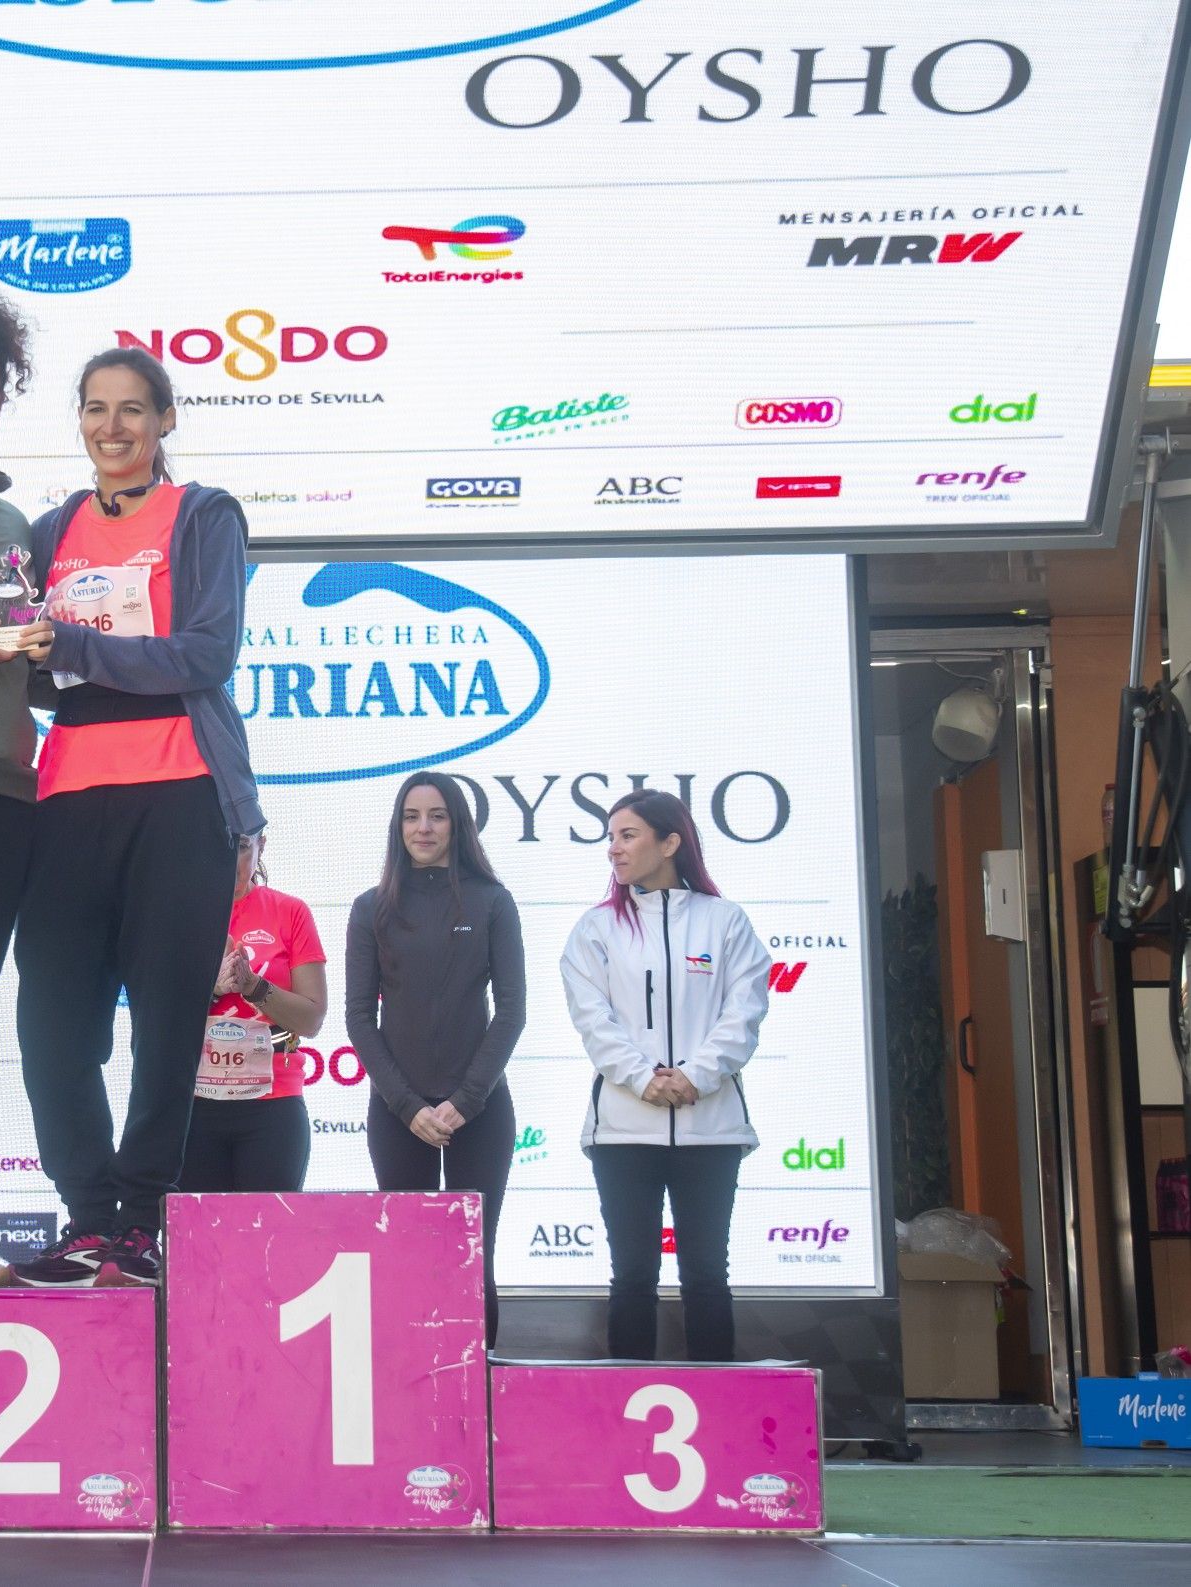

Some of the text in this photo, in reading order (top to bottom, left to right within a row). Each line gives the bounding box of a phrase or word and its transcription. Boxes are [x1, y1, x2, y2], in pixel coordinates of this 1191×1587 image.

[464, 38, 1033, 130] OYSHO
[778, 204, 1085, 225] MENSAJERÍA OFICIAL
[806, 230, 1024, 268] MRW
[381, 269, 524, 284] TotalEnergies
[176, 394, 272, 406] TAMIENTO
[278, 393, 303, 405] DE
[491, 391, 630, 431] Batiste
[745, 400, 834, 425] COSMO
[948, 391, 1038, 424] dial
[430, 480, 518, 497] GOYA
[596, 476, 683, 496] ABC
[915, 464, 1027, 491] renfe
[242, 625, 490, 646] RAL LECHERA
[224, 659, 510, 719] URIANA
[770, 935, 847, 948] OFICIAL
[209, 1051, 245, 1066] 016
[297, 1046, 367, 1086] DO
[195, 1086, 217, 1095] YSHO
[782, 1136, 845, 1171] dial
[530, 1224, 595, 1247] ABC
[767, 1219, 850, 1250] renfe
[279, 1251, 375, 1467] 1
[1118, 1393, 1186, 1429] Marlene
[622, 1384, 708, 1512] 3
